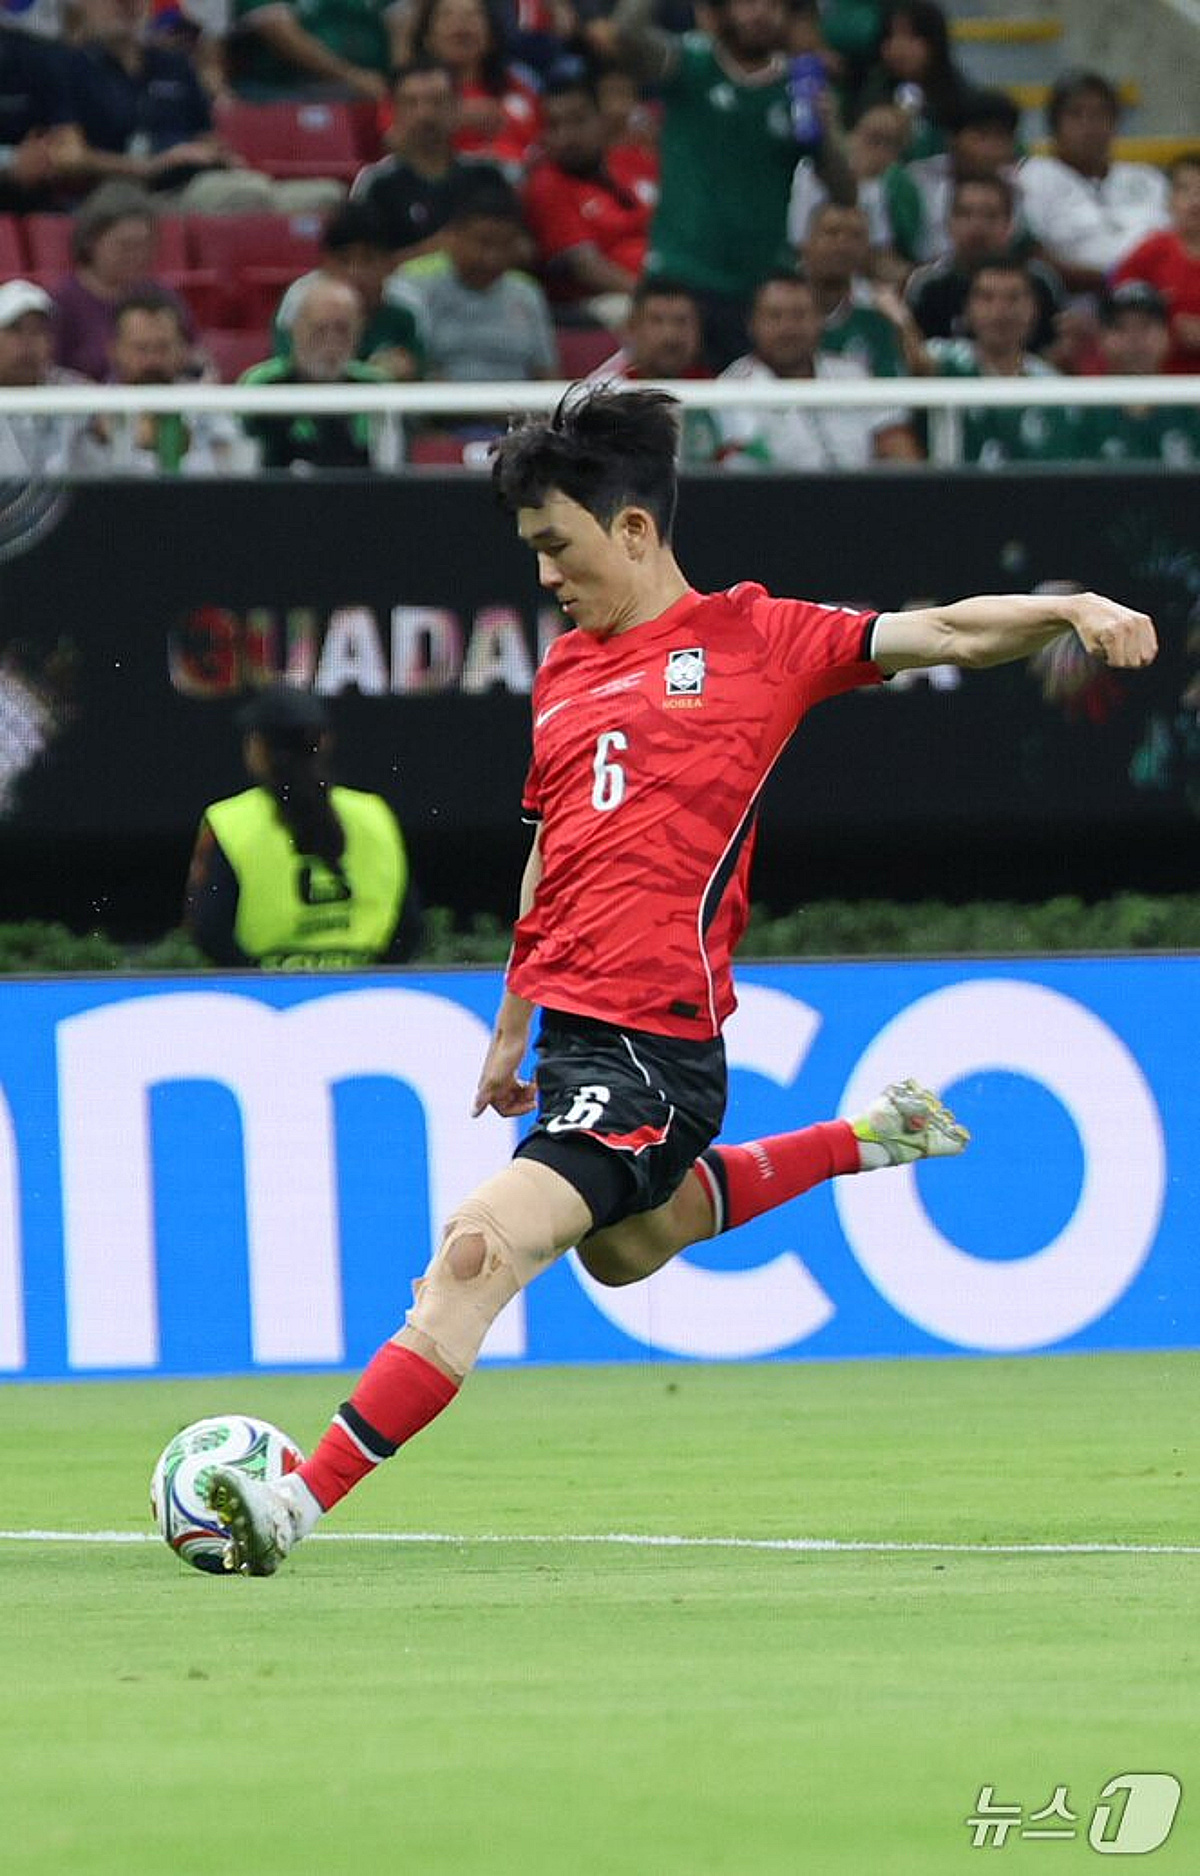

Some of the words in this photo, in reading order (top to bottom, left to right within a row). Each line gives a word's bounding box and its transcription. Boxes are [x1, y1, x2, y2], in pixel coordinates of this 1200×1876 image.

[592, 730, 628, 812] 6
[546, 1085, 611, 1133] 6
[0, 980, 1166, 1370] mco
